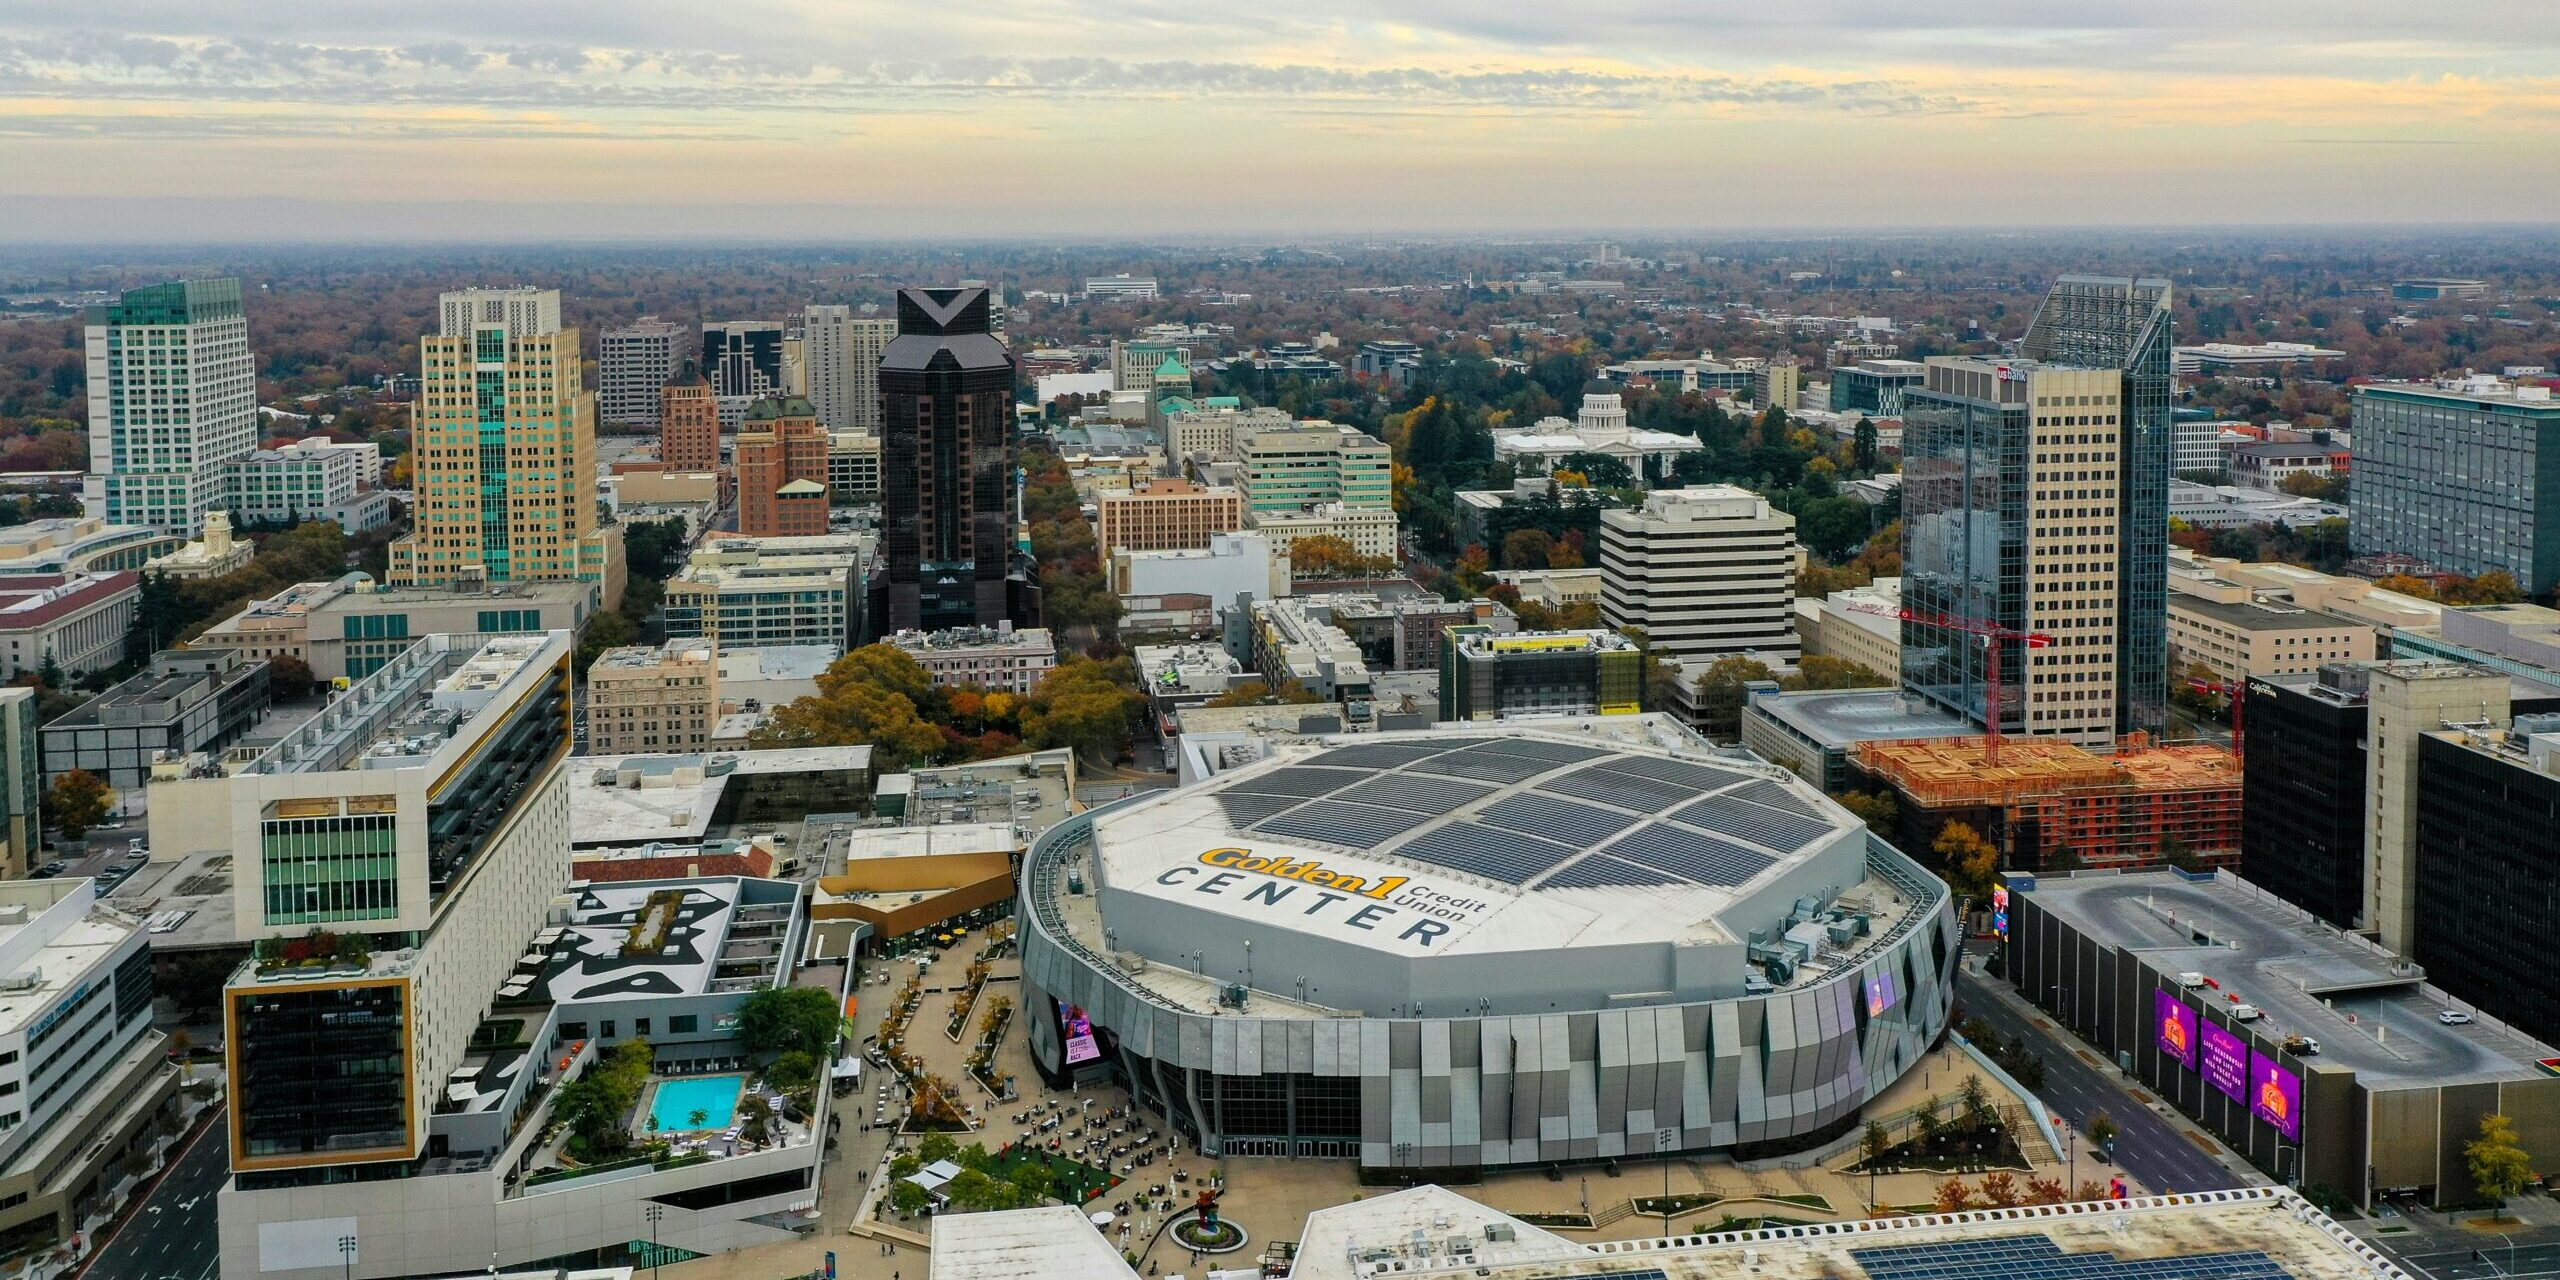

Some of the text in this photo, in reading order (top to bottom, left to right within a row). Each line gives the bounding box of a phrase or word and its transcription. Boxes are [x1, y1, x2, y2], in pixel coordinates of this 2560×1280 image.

[1156, 867, 1450, 946] CENTER
[1394, 895, 1465, 921] Union
[1409, 886, 1487, 913] Credit
